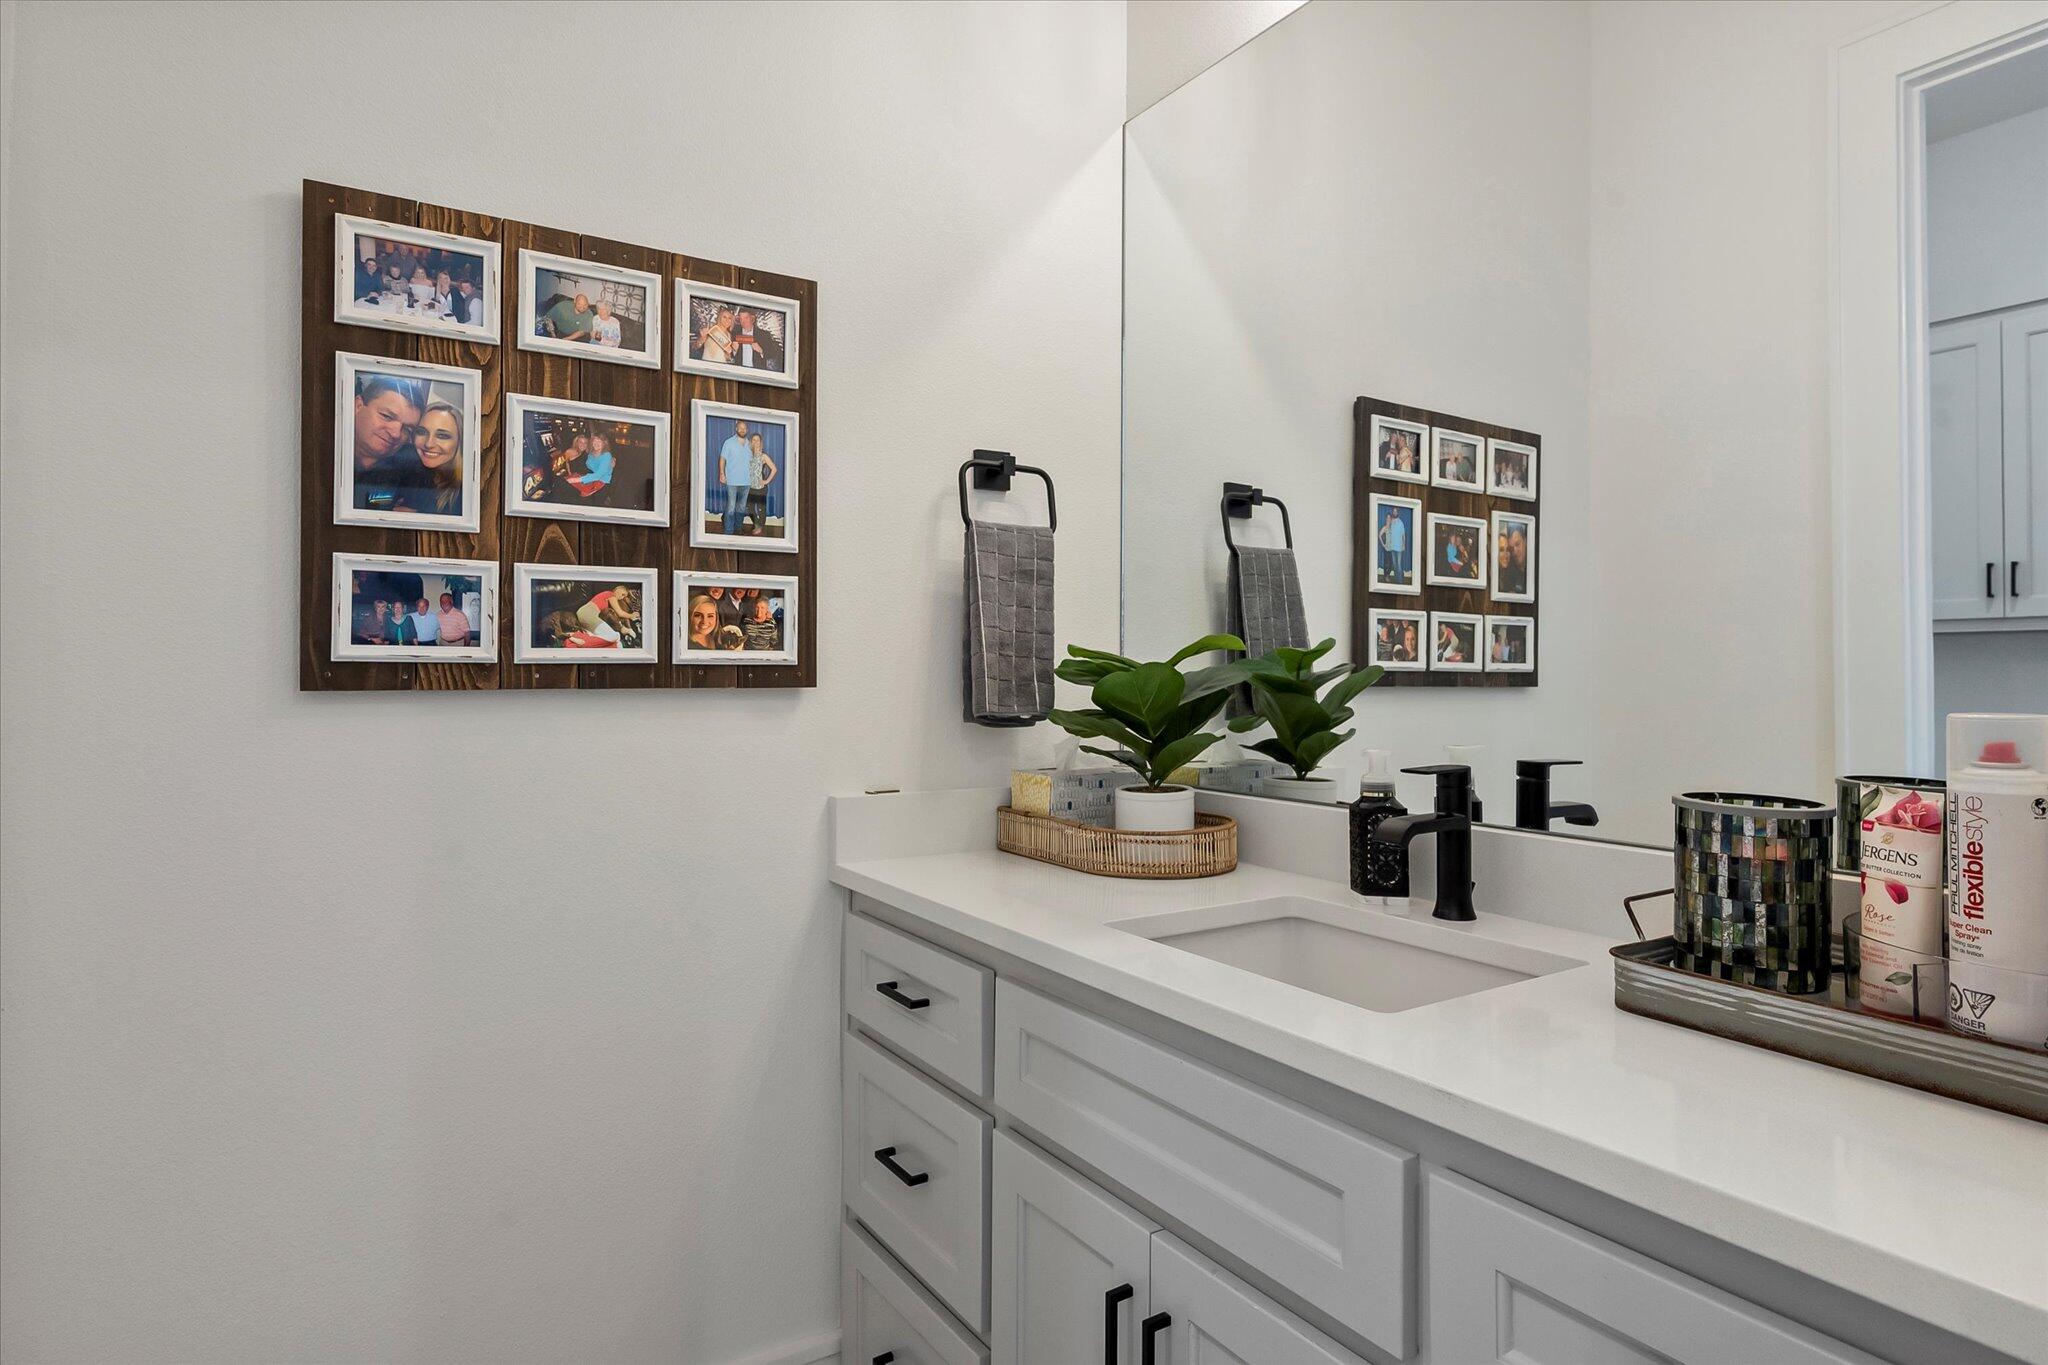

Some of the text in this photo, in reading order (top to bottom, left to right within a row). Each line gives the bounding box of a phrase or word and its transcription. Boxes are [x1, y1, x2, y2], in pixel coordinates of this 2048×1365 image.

[1861, 841, 1918, 866] JERGENS
[1949, 792, 1958, 915] PAUL MITCHELL
[1962, 795, 1988, 919] flexiblestyle
[1883, 867, 1922, 879] COLLECTION
[1864, 903, 1895, 920] Rose
[1965, 923, 1992, 935] Clean
